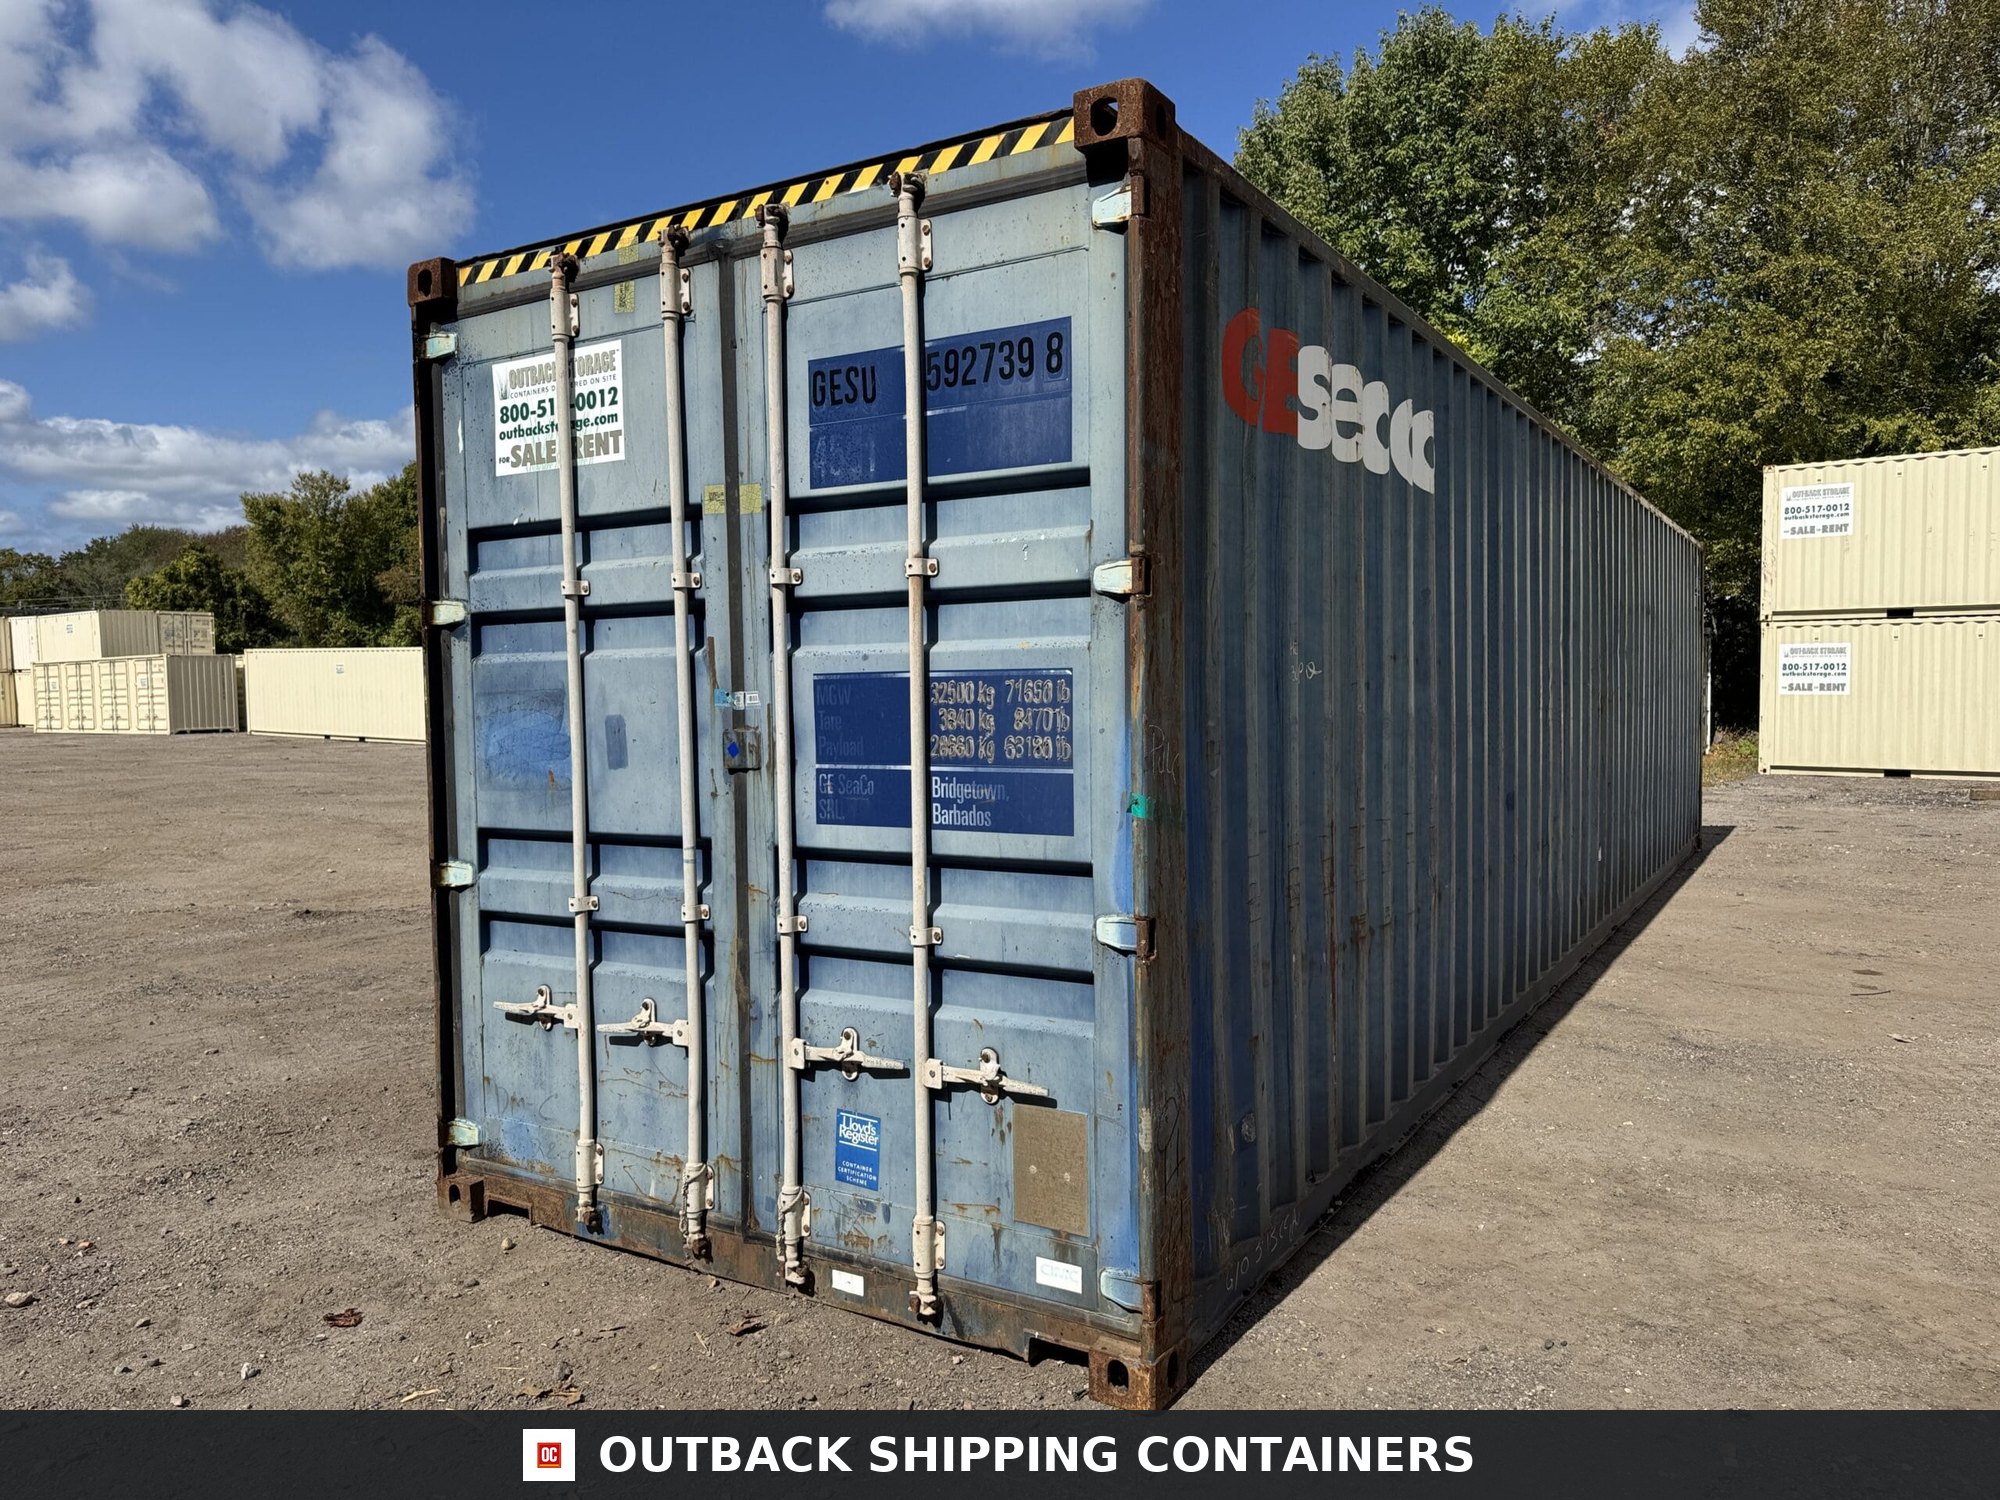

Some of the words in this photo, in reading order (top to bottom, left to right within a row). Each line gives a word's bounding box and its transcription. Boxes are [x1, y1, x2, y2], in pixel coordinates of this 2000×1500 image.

[568, 350, 616, 377] TORAGE
[812, 365, 877, 407] GESU
[926, 336, 1034, 392] 592739
[1046, 332, 1063, 373] 8
[510, 385, 549, 399] CONTAINERS
[590, 377, 600, 385] ON
[602, 374, 616, 383] SITE
[500, 386, 618, 424] 800-51-0012
[510, 440, 557, 468] SALE
[571, 430, 622, 459] RENT
[1784, 503, 1850, 515] 800-517-0012
[1790, 525, 1816, 535] SALE
[1822, 523, 1849, 533] RENT
[1782, 662, 1847, 671] 800-517-0012
[931, 680, 975, 704] 32500
[977, 681, 996, 710] kg
[1005, 679, 1053, 704] 71650
[1788, 683, 1813, 692] SALE
[1819, 683, 1846, 692] RENT
[818, 710, 842, 730] Tare
[939, 708, 975, 731] 3840
[978, 708, 995, 736] kg
[1014, 707, 1053, 732] 8470
[818, 735, 864, 761] Payload
[819, 773, 834, 795] GE
[838, 774, 875, 796] SeaCo
[932, 803, 992, 827] Barbados
[839, 1124, 879, 1146] Register
[843, 1115, 877, 1136] Lloyd's
[838, 1166, 877, 1181] CERTIFICATION
[842, 1160, 873, 1173] CONTAINER
[846, 1175, 867, 1187] SCHEME
